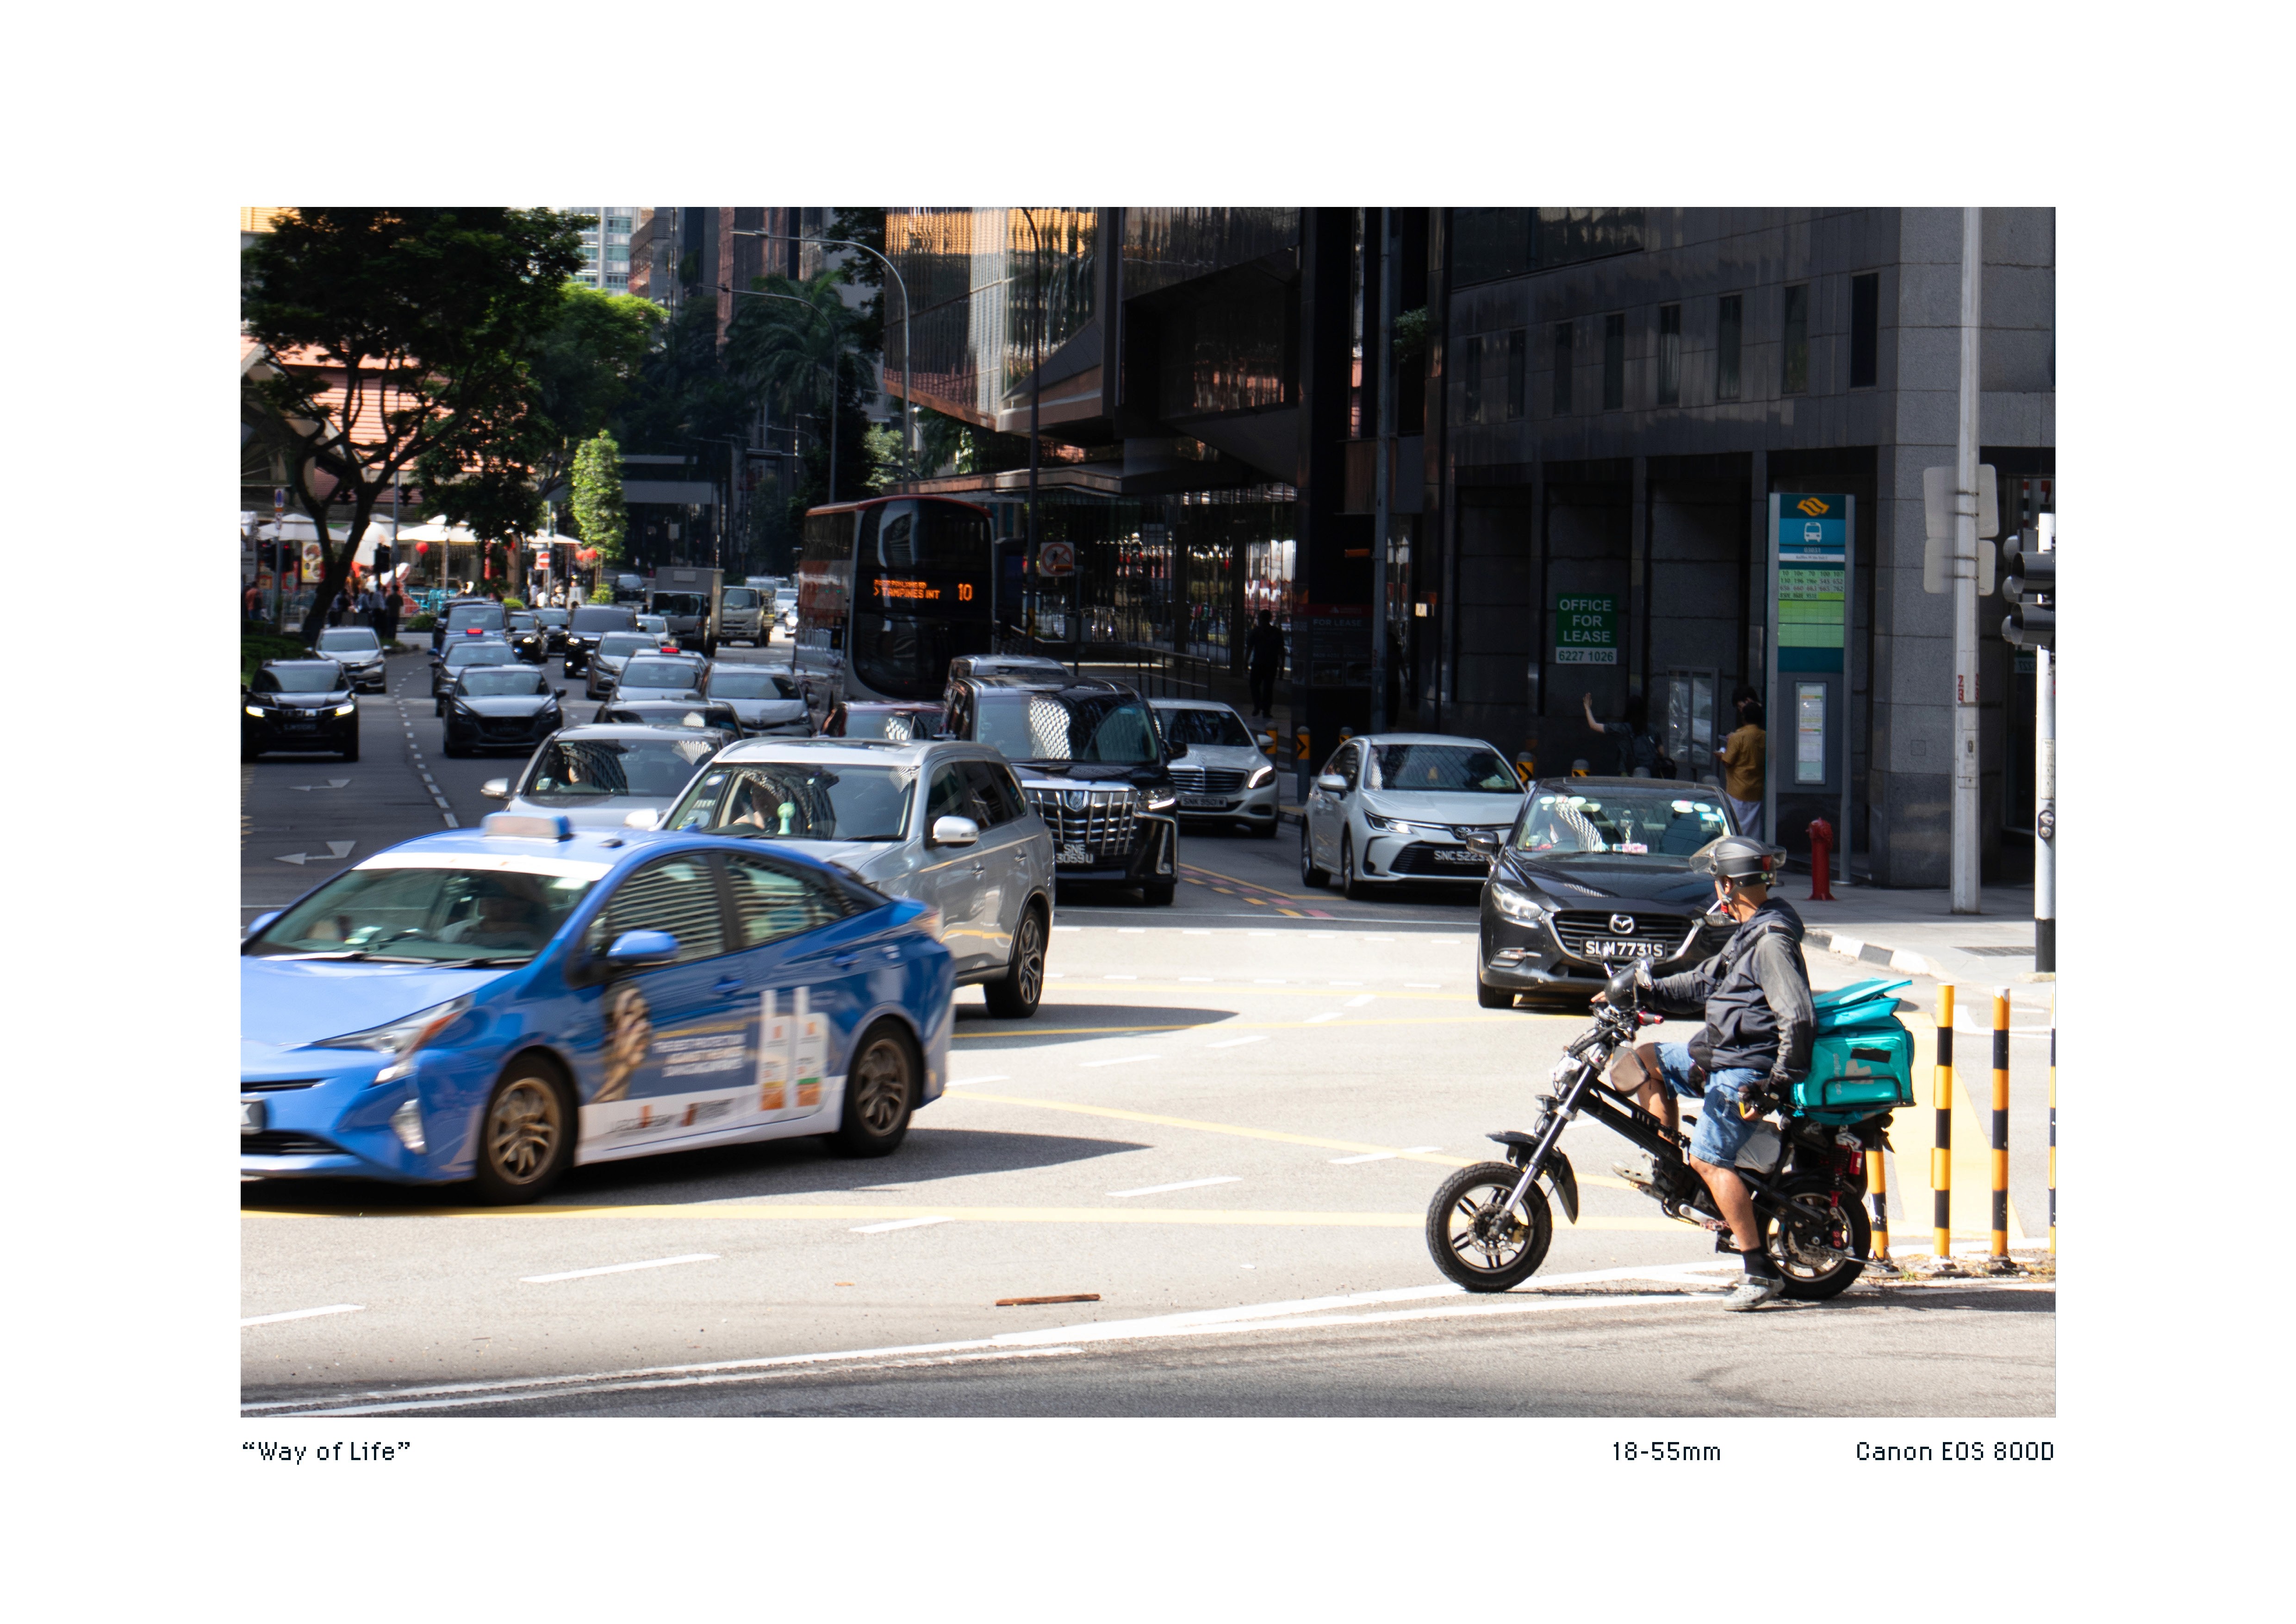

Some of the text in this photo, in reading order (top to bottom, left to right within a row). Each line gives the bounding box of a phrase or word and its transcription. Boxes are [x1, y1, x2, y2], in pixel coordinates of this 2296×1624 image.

[882, 587, 940, 600] TAMPINES INT
[957, 583, 973, 601] 10
[1559, 599, 1612, 612] OFFICE
[1573, 615, 1602, 627] FOR
[1563, 631, 1611, 643] LEASE
[1558, 651, 1614, 662] 6227 1026
[1063, 843, 1086, 855] SNE
